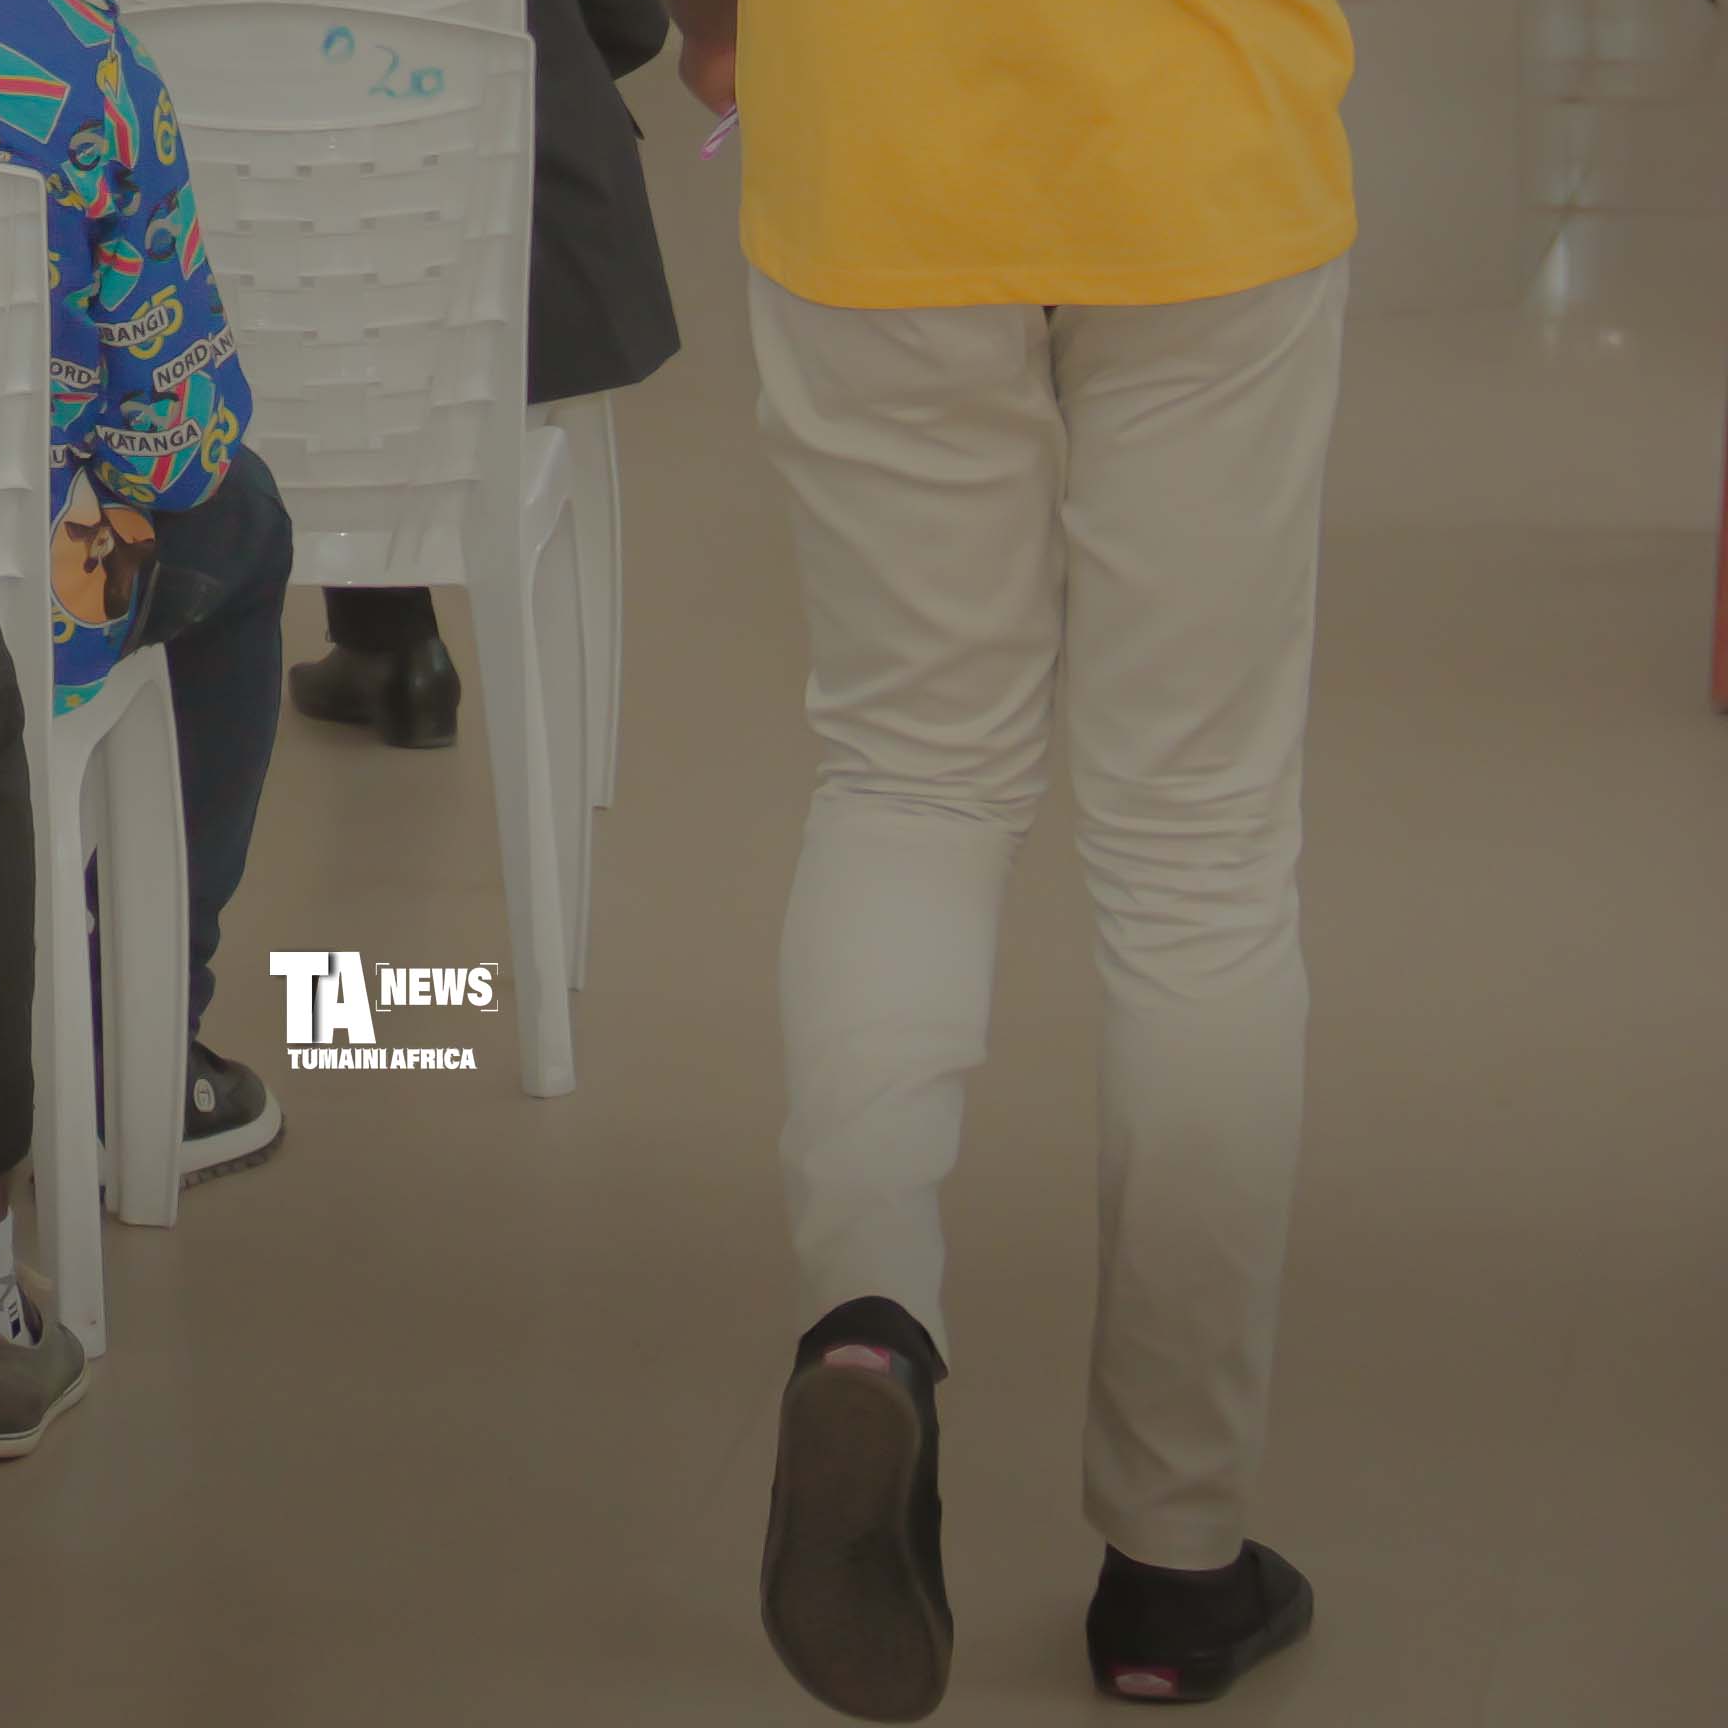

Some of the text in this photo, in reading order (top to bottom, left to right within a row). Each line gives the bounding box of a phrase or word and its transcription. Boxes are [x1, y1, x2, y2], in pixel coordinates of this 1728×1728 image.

[50, 362, 92, 384] ORD
[157, 344, 209, 387] NORD
[104, 423, 199, 452] KATANGA
